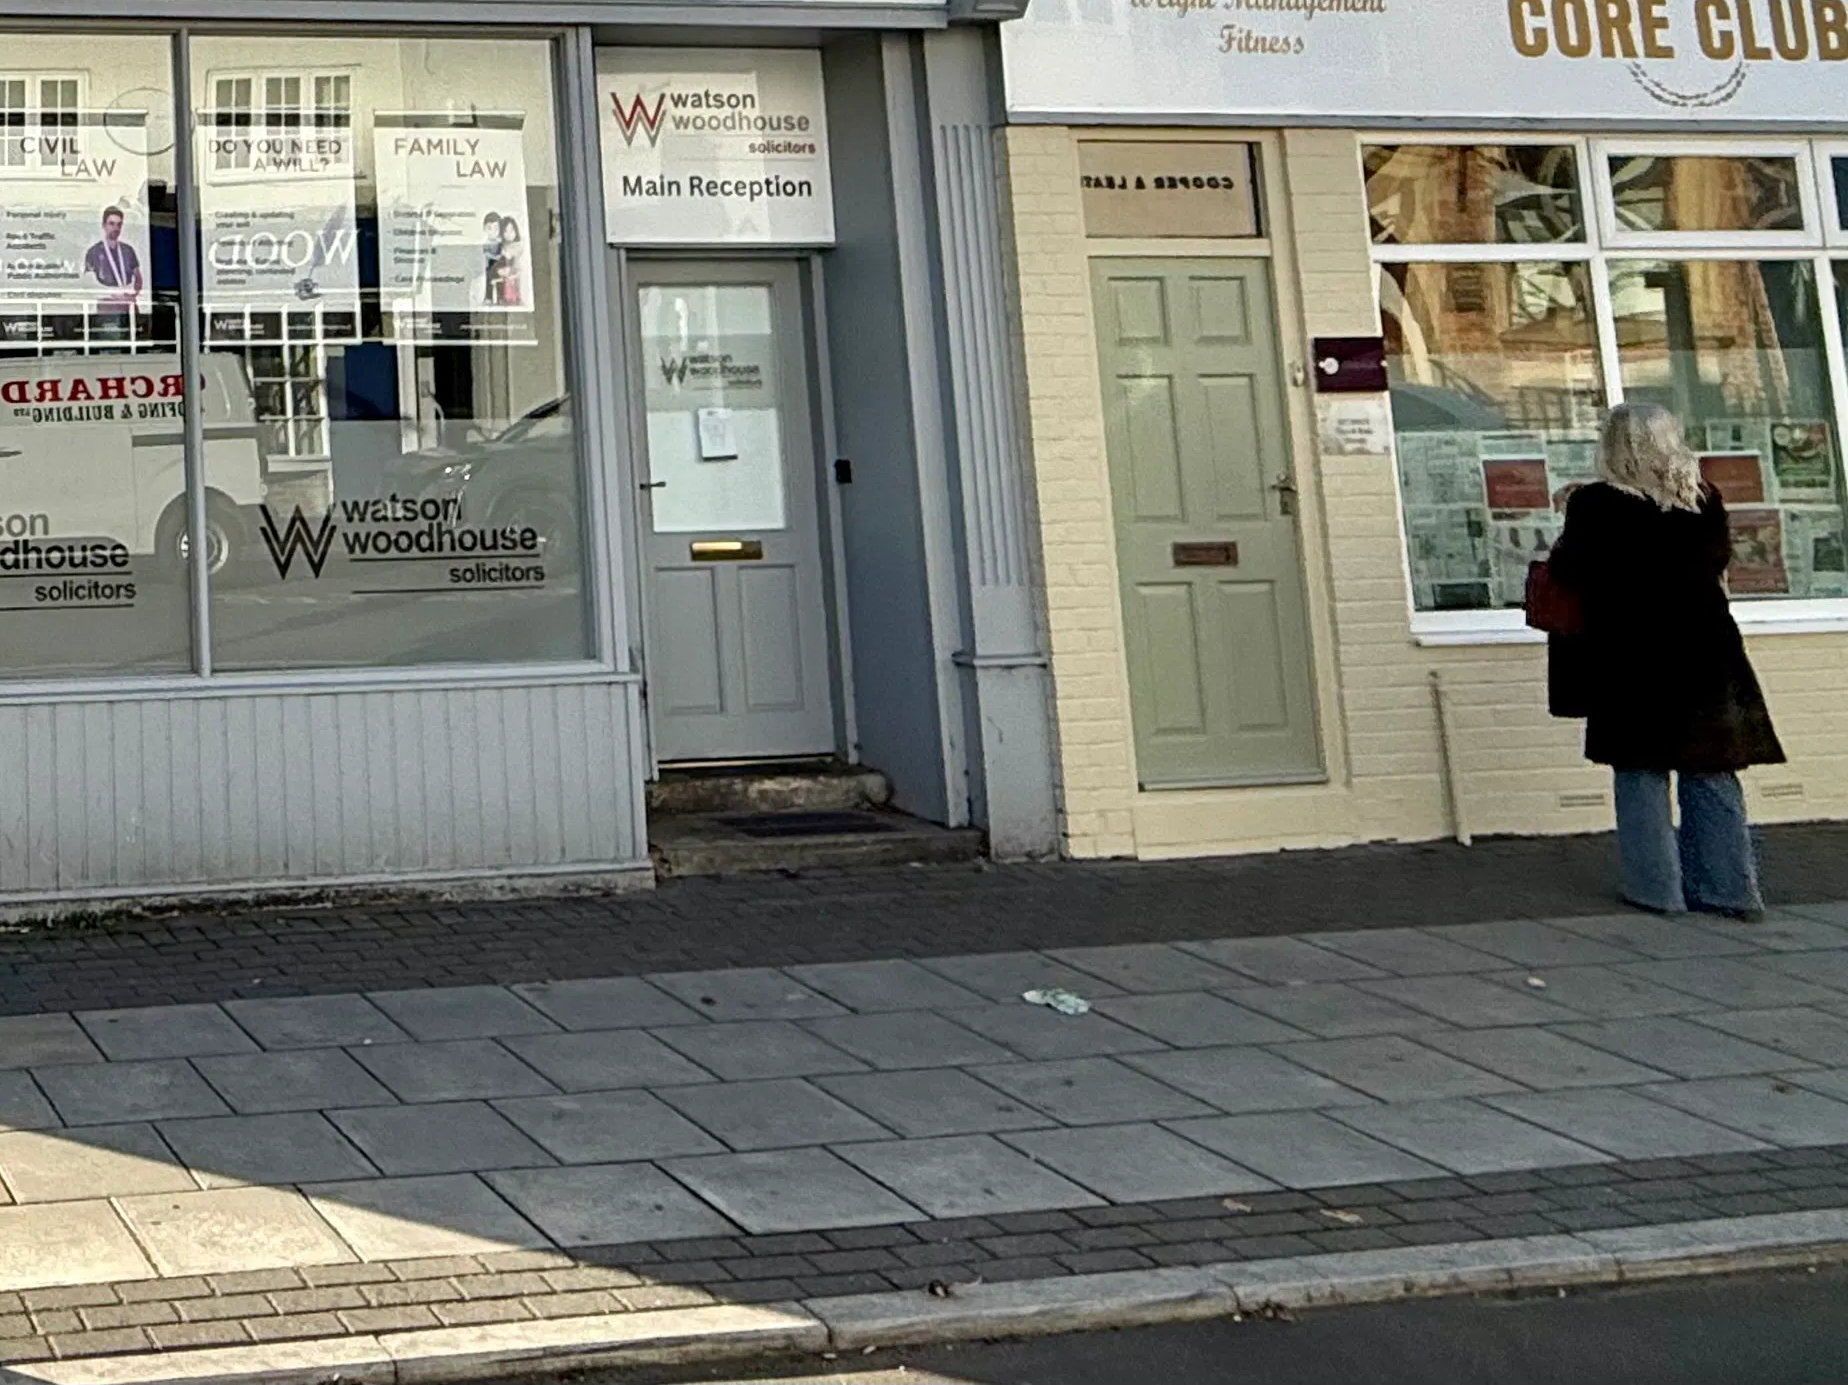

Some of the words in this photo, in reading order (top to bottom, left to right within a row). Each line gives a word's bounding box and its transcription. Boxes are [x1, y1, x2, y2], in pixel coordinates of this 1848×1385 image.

[1218, 23, 1305, 55] Fitness
[670, 88, 756, 109] watson
[671, 110, 811, 132] woodhouse
[20, 136, 82, 155] CIVIL
[208, 138, 238, 155] DO
[242, 137, 284, 155] YOU
[290, 139, 342, 155] NEED
[394, 137, 480, 157] FAMILY
[748, 139, 816, 155] solicitors
[61, 158, 117, 178] LAW
[253, 157, 266, 172] A
[272, 156, 330, 173] WILL?
[455, 160, 508, 179] LAW
[622, 174, 681, 197] Main
[689, 175, 813, 201] Reception
[341, 493, 462, 523] watson
[342, 522, 539, 556] woodhouse
[449, 561, 545, 585] solicitors
[35, 579, 137, 602] solicitors
